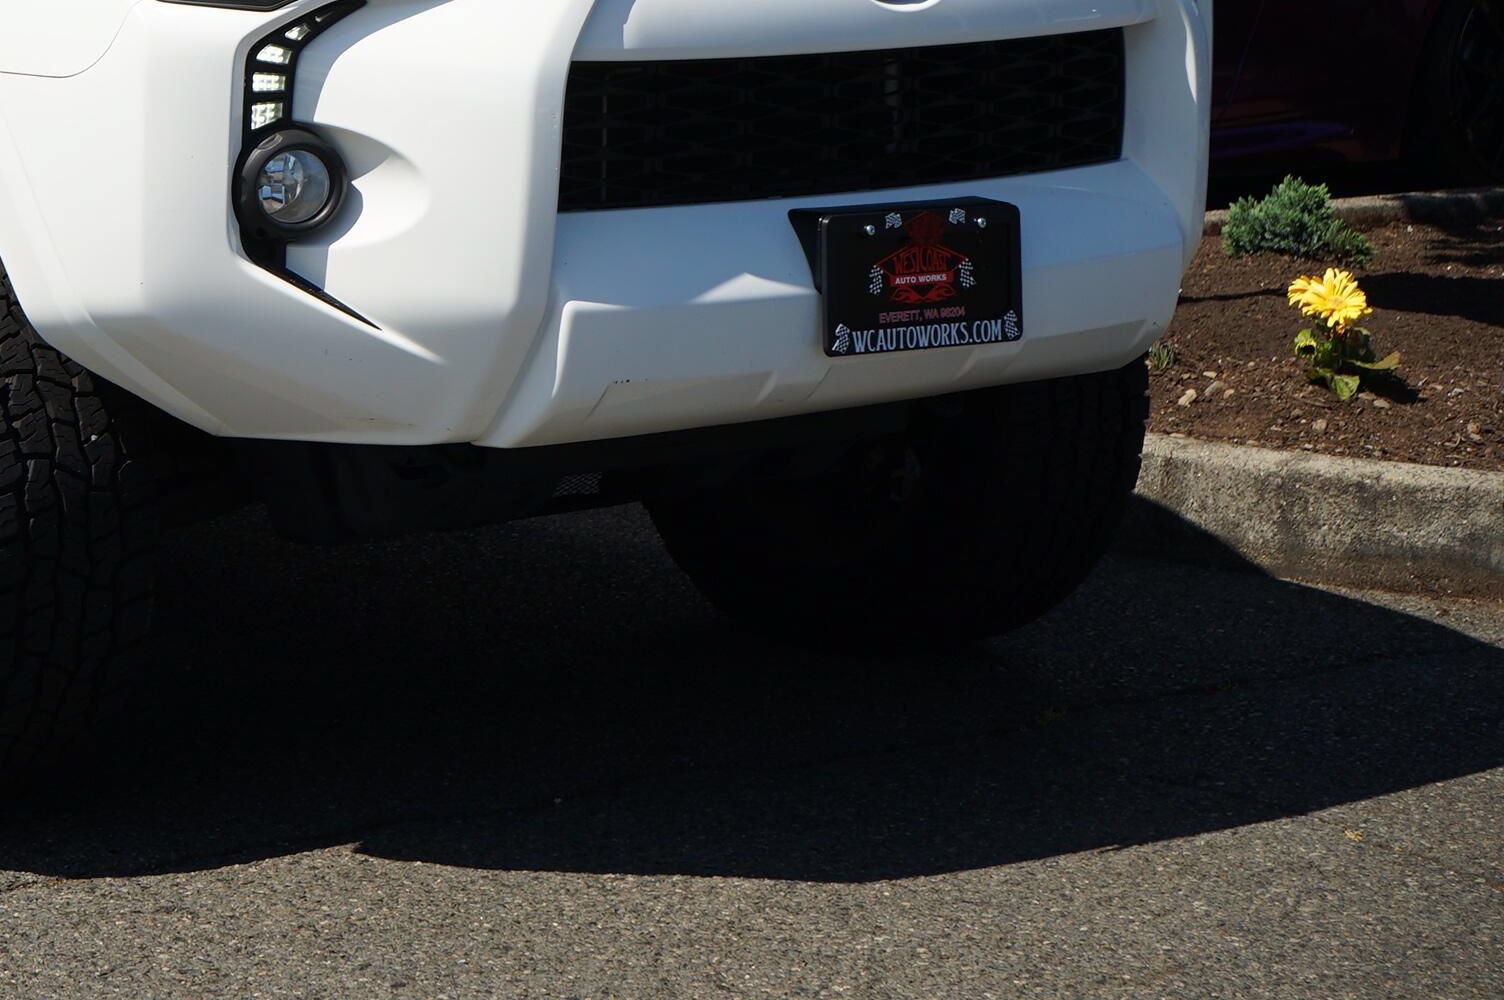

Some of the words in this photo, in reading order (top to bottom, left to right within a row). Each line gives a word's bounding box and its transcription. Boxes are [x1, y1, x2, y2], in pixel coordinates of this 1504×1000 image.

[895, 275, 917, 285] AUTO
[918, 273, 947, 283] WORKS
[924, 308, 940, 319] WA
[853, 319, 1002, 353] WCAUTOWORKS.COM
